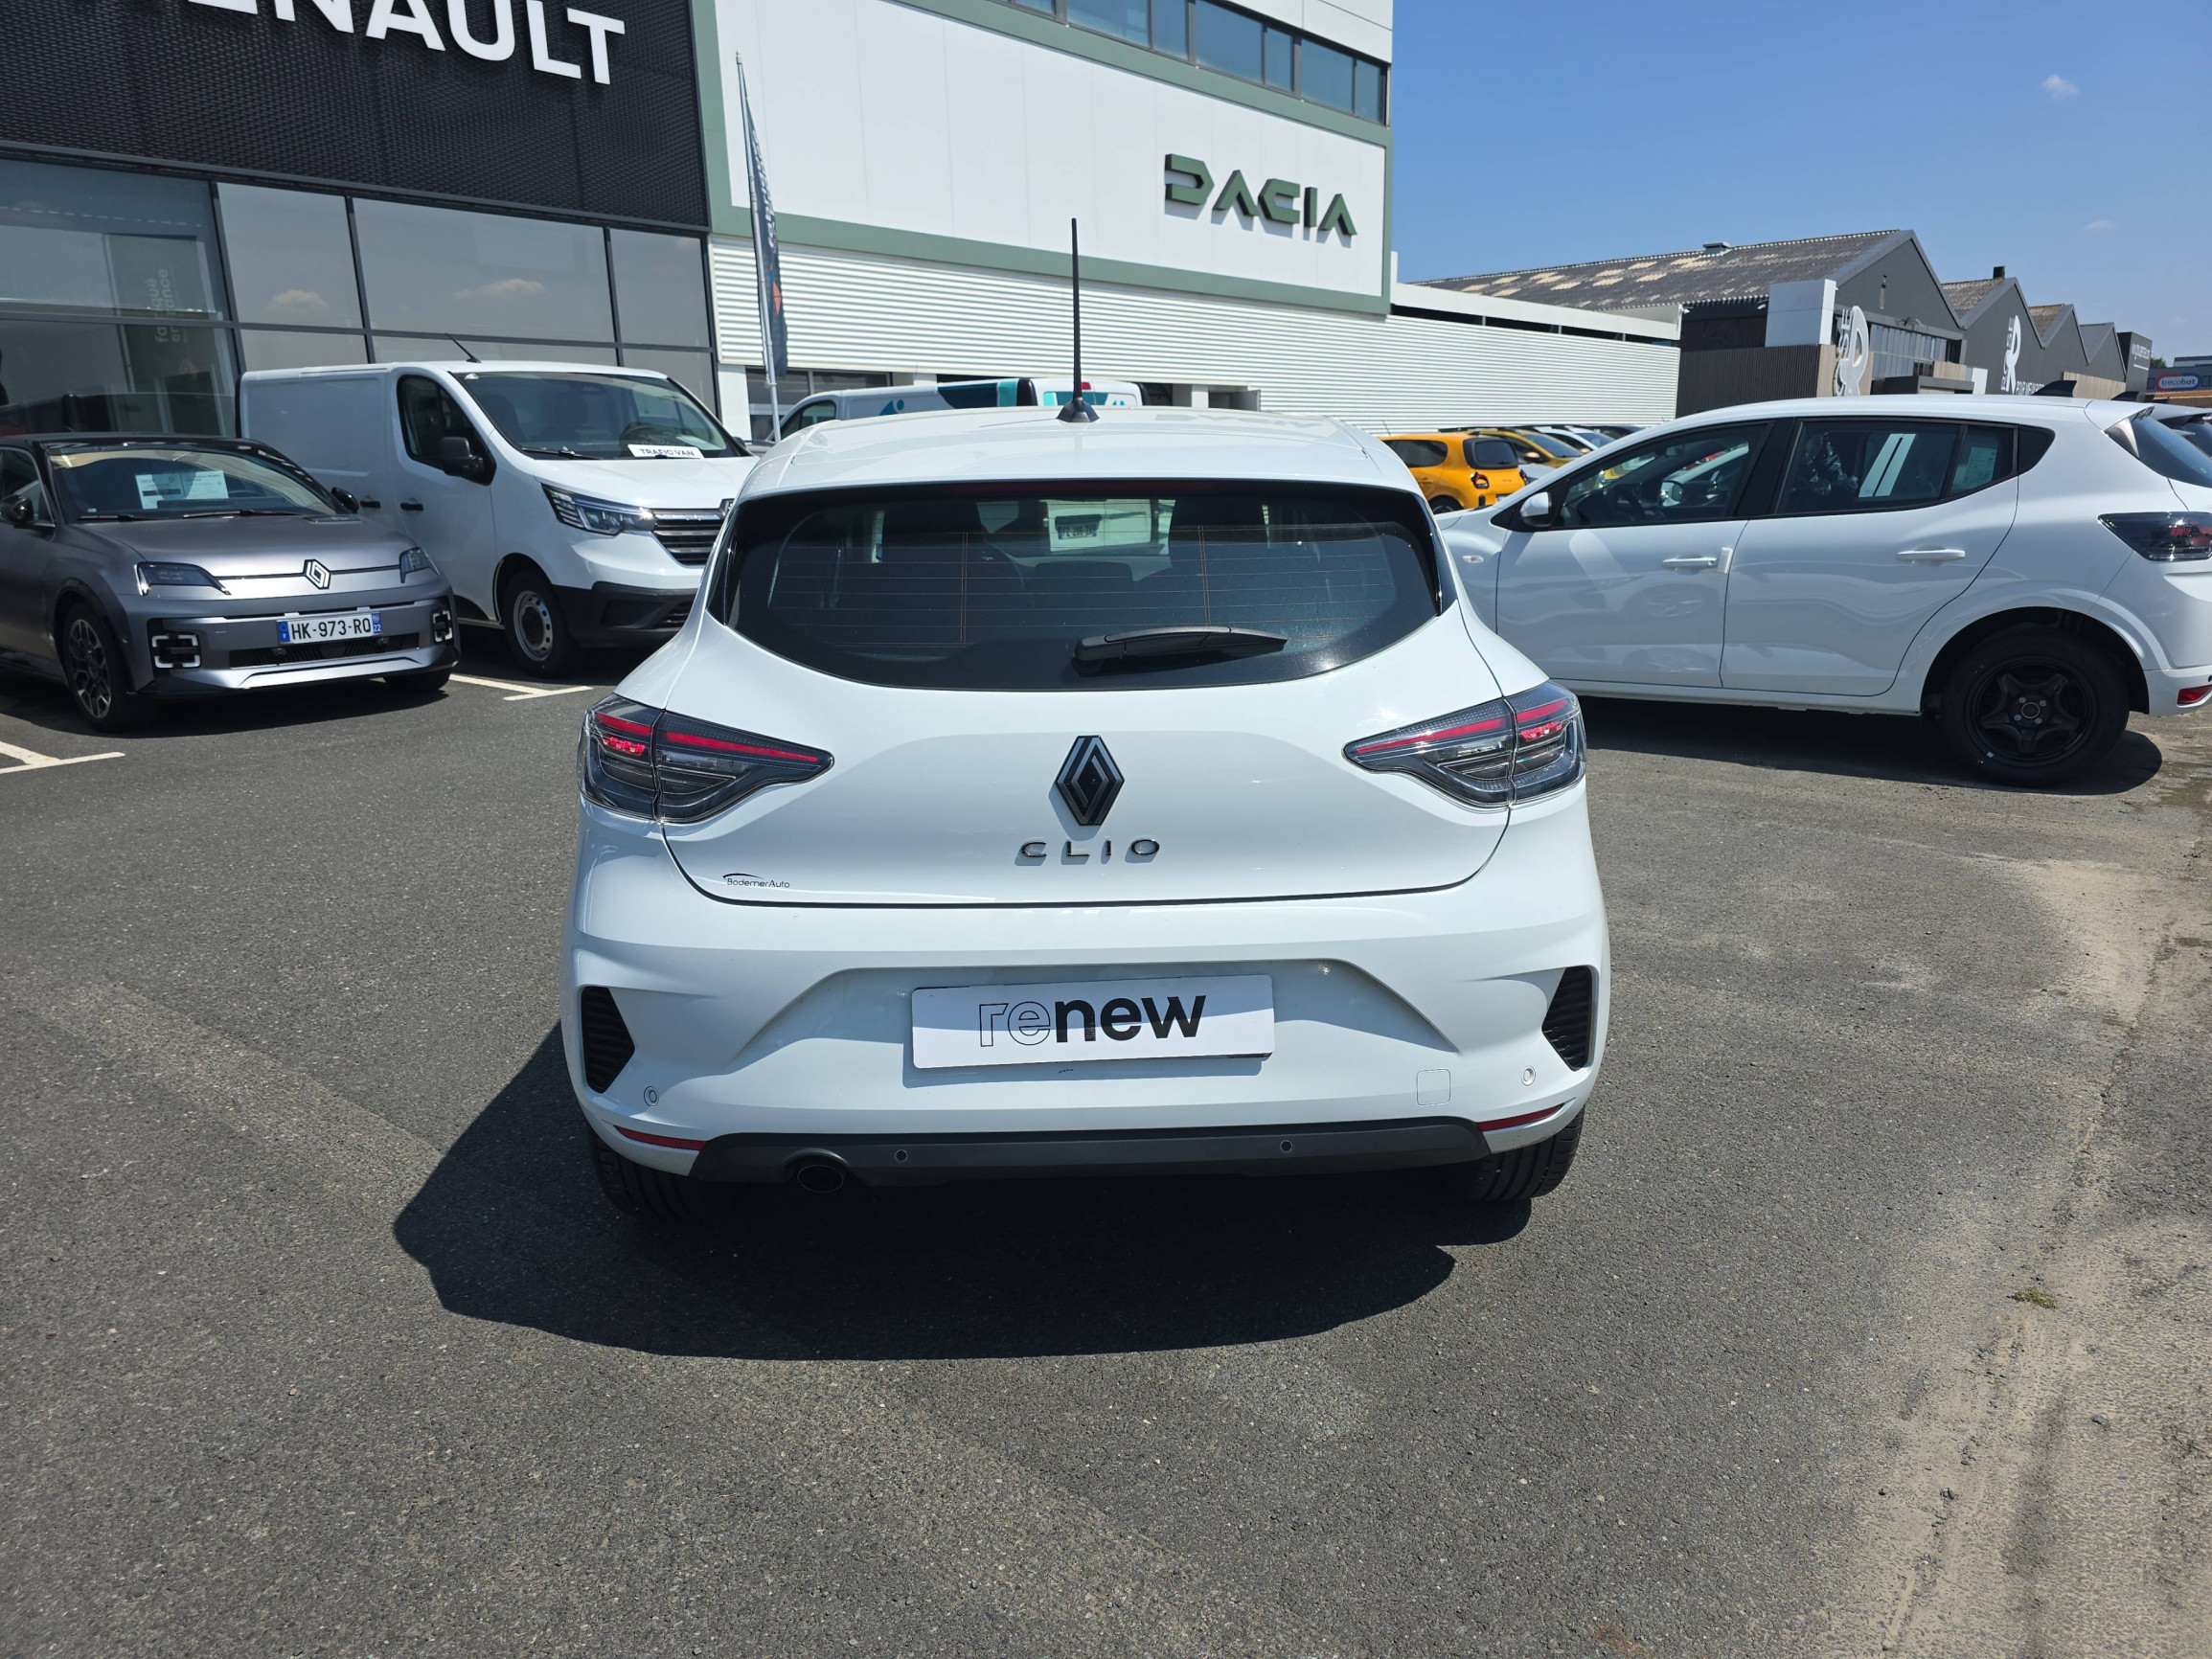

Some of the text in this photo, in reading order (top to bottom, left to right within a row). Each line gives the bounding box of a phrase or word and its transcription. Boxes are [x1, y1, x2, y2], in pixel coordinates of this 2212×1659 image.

[1165, 153, 1358, 236] DACIA
[2161, 377, 2196, 387] trecobat
[1021, 839, 1160, 858] CLIO
[978, 994, 1207, 1047] renew
